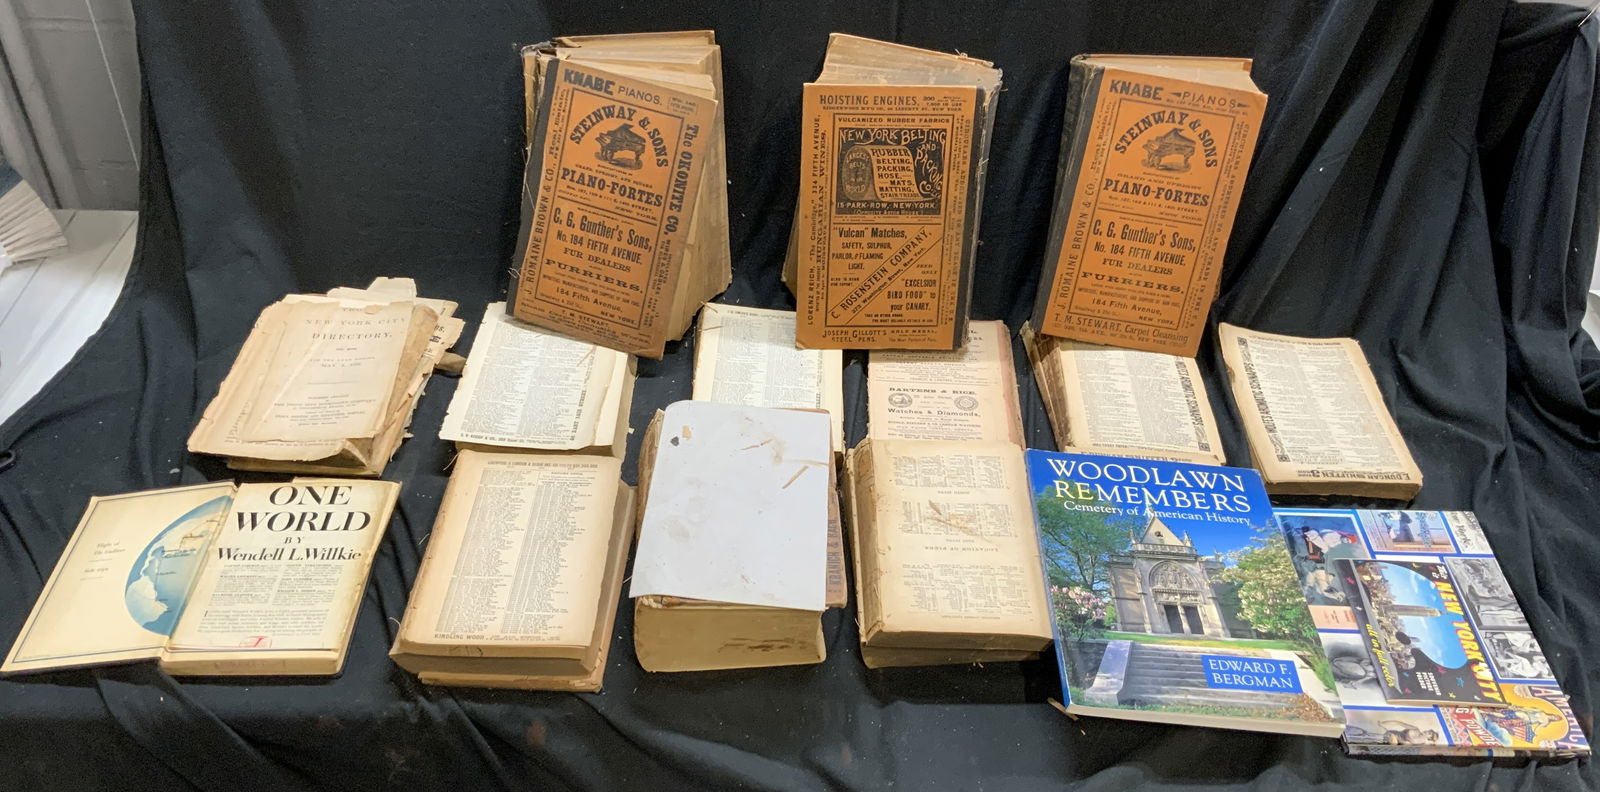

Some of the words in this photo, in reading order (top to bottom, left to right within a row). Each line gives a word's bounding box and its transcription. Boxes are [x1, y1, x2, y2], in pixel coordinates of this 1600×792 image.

[563, 68, 615, 96] KNABE
[618, 86, 662, 106] PIANOS.
[1109, 79, 1164, 100] KNABE
[1182, 91, 1238, 108] PIANOS
[820, 95, 869, 105] HOISTING
[873, 96, 919, 106] ENGINES.
[569, 105, 638, 144] STEINWAY
[639, 116, 650, 130] &
[648, 128, 668, 168] SONS
[682, 124, 699, 147] The
[840, 129, 865, 145] NEW
[865, 128, 899, 145] YORK
[900, 129, 947, 145] BELTING
[922, 142, 937, 151] AND
[1115, 110, 1189, 155] STEINWAY
[1189, 118, 1201, 132] &
[1199, 129, 1218, 169] SONS
[872, 149, 911, 157] RUBBER
[561, 168, 663, 207] PIANO-FORTES
[669, 150, 693, 212] OKONITE
[1103, 178, 1210, 207] PIANO-FORTES
[526, 238, 541, 282] ROMAINE
[536, 196, 548, 234] BROWN
[545, 185, 552, 193] &
[554, 208, 562, 224] C.
[566, 212, 575, 228] G.
[579, 216, 623, 241] Gunther's
[627, 229, 652, 251] Sons,
[871, 228, 907, 239] Matches,
[1092, 219, 1102, 236] C.
[1106, 222, 1116, 239] G.
[1120, 224, 1166, 247] Gunther's
[1171, 232, 1196, 252] Sons,
[556, 230, 567, 242] No.
[570, 233, 584, 247] 184
[587, 239, 608, 253] FIFTH
[611, 247, 642, 264] AVENUE.
[842, 242, 864, 250] SAFETY,
[1060, 254, 1078, 298] ROMAINE
[1072, 213, 1088, 249] BROWN
[1085, 201, 1091, 209] &
[1094, 242, 1106, 252] No.
[1110, 244, 1125, 256] 184
[1128, 246, 1151, 260] FIFTH
[1154, 251, 1186, 267] AVENUE.
[564, 248, 583, 259] FUR
[588, 255, 631, 272] DEALERS
[1102, 258, 1123, 268] FUR
[1127, 261, 1173, 276] DEALERS
[556, 287, 569, 295] 184
[572, 290, 590, 302] Fifth
[840, 267, 889, 311] ROSENSTEIN
[1081, 272, 1184, 295] FURRIERS.
[601, 311, 615, 319] NEW
[890, 304, 903, 312] your
[1091, 298, 1106, 306] 184
[1109, 299, 1128, 310] Fifth
[312, 332, 393, 340] DIRECTORY.
[822, 330, 849, 338] JOSEPH
[1054, 313, 1061, 322] T.
[1064, 315, 1074, 325] M.
[1125, 324, 1149, 336] Carpet
[1152, 329, 1188, 344] Cleansing
[1047, 458, 1245, 492] WOODLAWN
[270, 486, 352, 505] ONE
[1053, 480, 1251, 513] REMEMBERS
[237, 511, 371, 532] WORLD
[1064, 501, 1123, 517] Cemetery
[1127, 506, 1139, 516] of
[1143, 507, 1203, 520] American
[1206, 512, 1250, 526] History
[218, 548, 284, 561] Wendell
[1432, 580, 1463, 616] NEW
[1452, 620, 1483, 660] YORK
[1471, 660, 1503, 702] CITY
[1208, 659, 1275, 674] EDWARD
[1279, 664, 1291, 674] F.
[1212, 673, 1293, 688] BERGMAN
